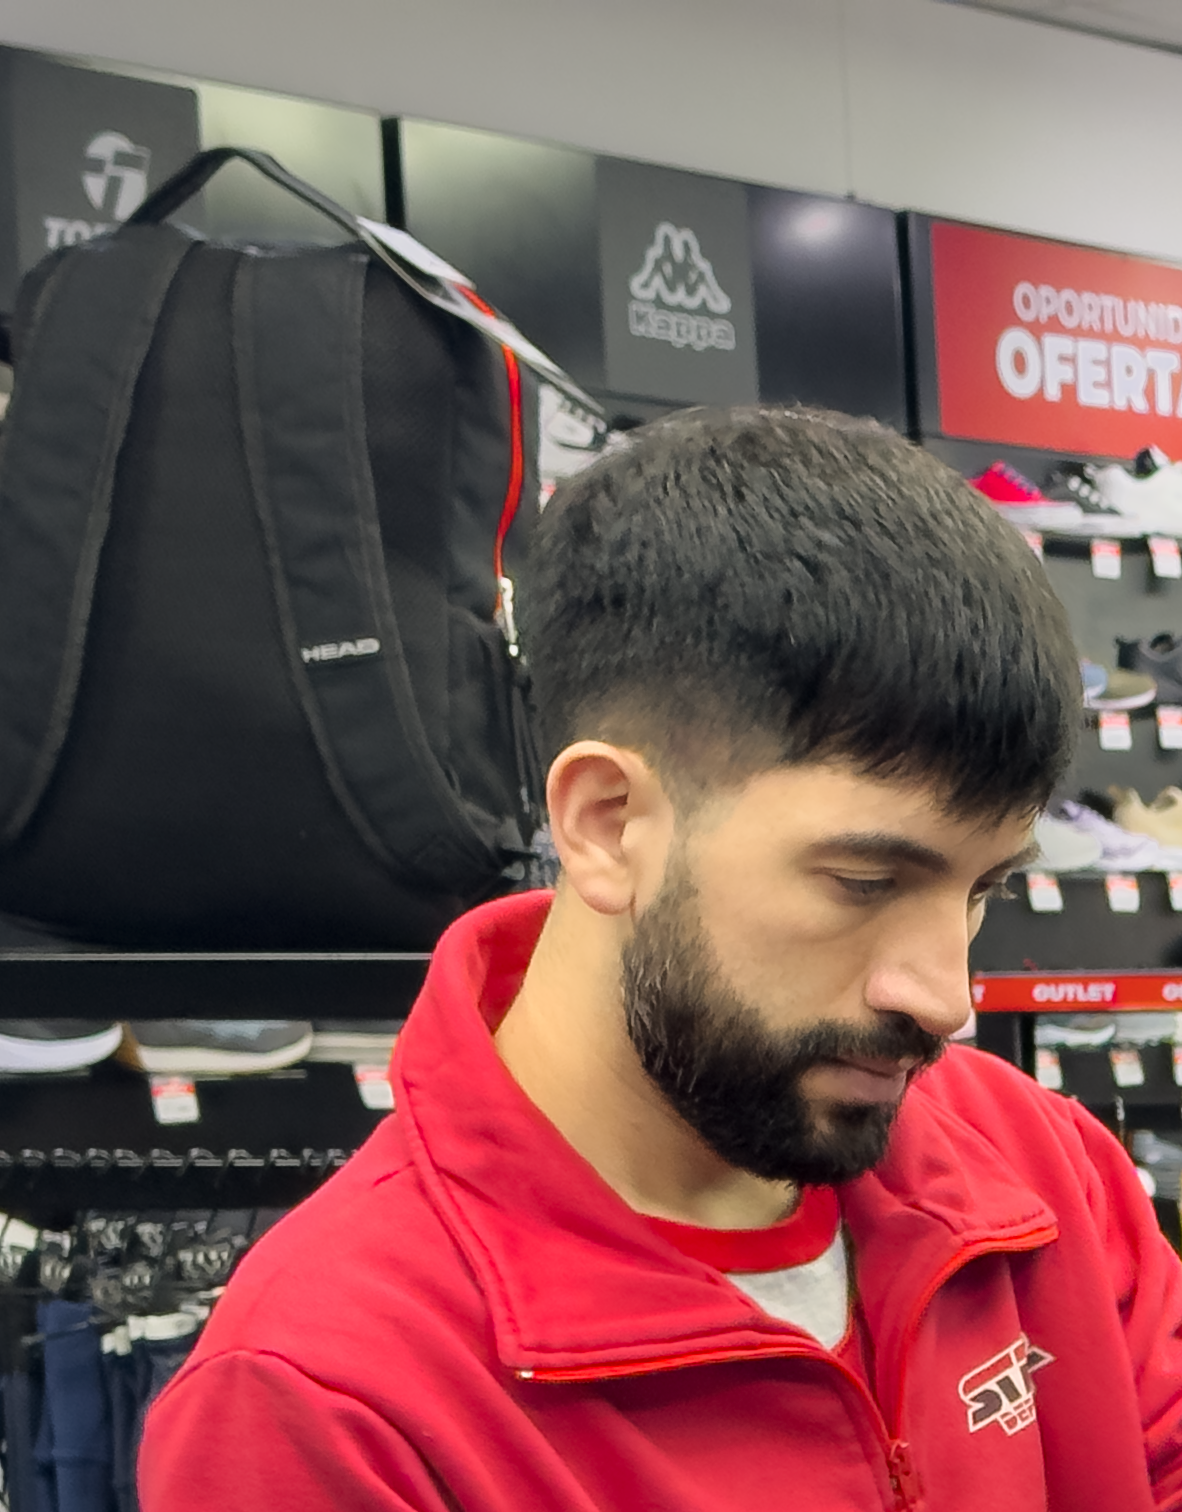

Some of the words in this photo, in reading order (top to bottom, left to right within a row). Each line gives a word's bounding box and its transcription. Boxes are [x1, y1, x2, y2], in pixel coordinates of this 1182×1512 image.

[628, 300, 736, 351] Kappa
[301, 637, 381, 664] HEAD
[1032, 983, 1116, 1003] OUTLET
